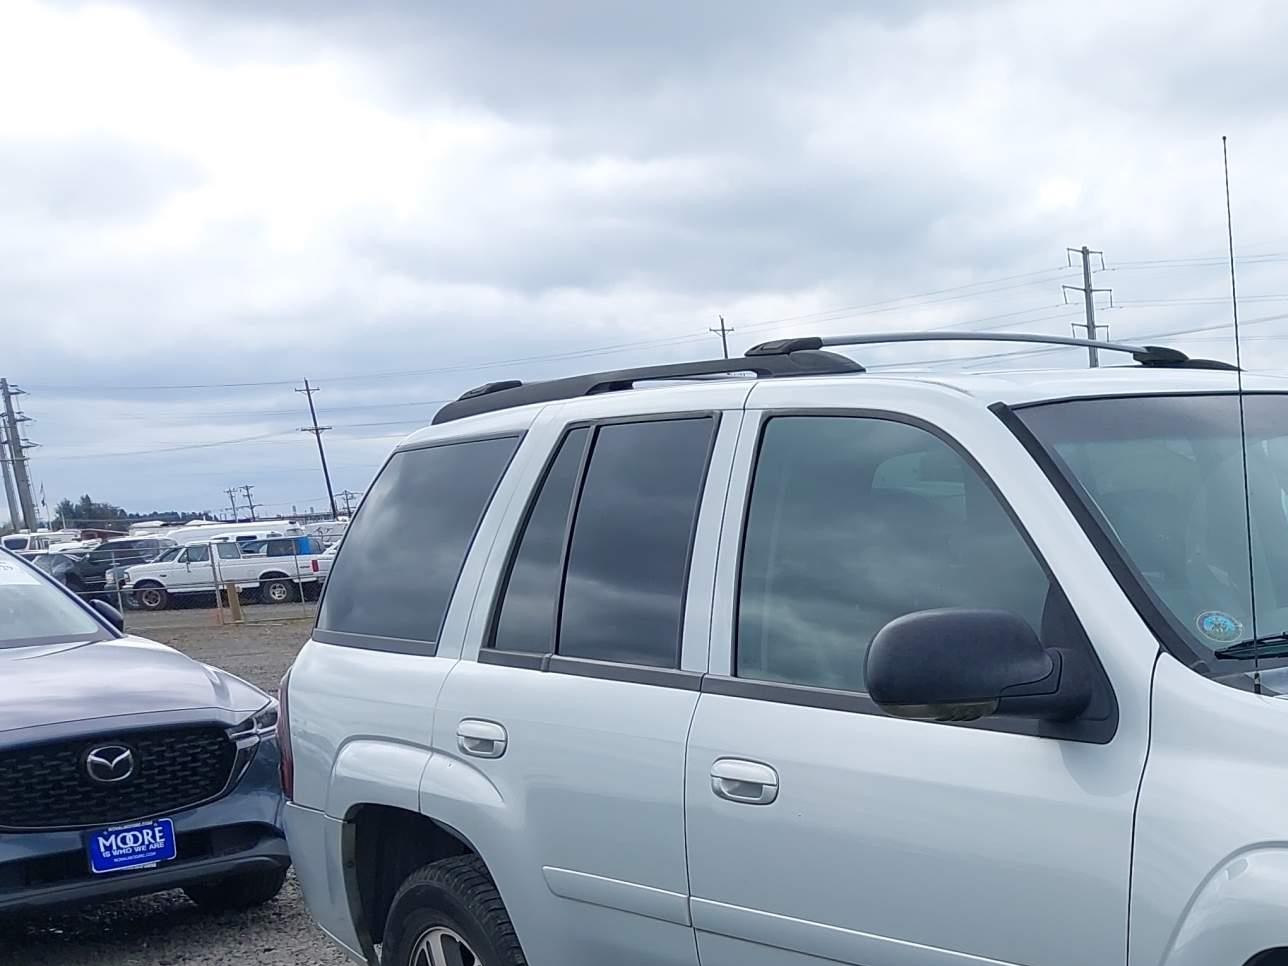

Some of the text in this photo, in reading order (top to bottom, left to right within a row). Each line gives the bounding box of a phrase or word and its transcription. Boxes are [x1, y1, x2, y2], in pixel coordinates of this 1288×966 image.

[97, 826, 166, 853] MOORE
[112, 847, 132, 856] WHO
[134, 844, 147, 853] WE
[149, 841, 164, 850] ARE
